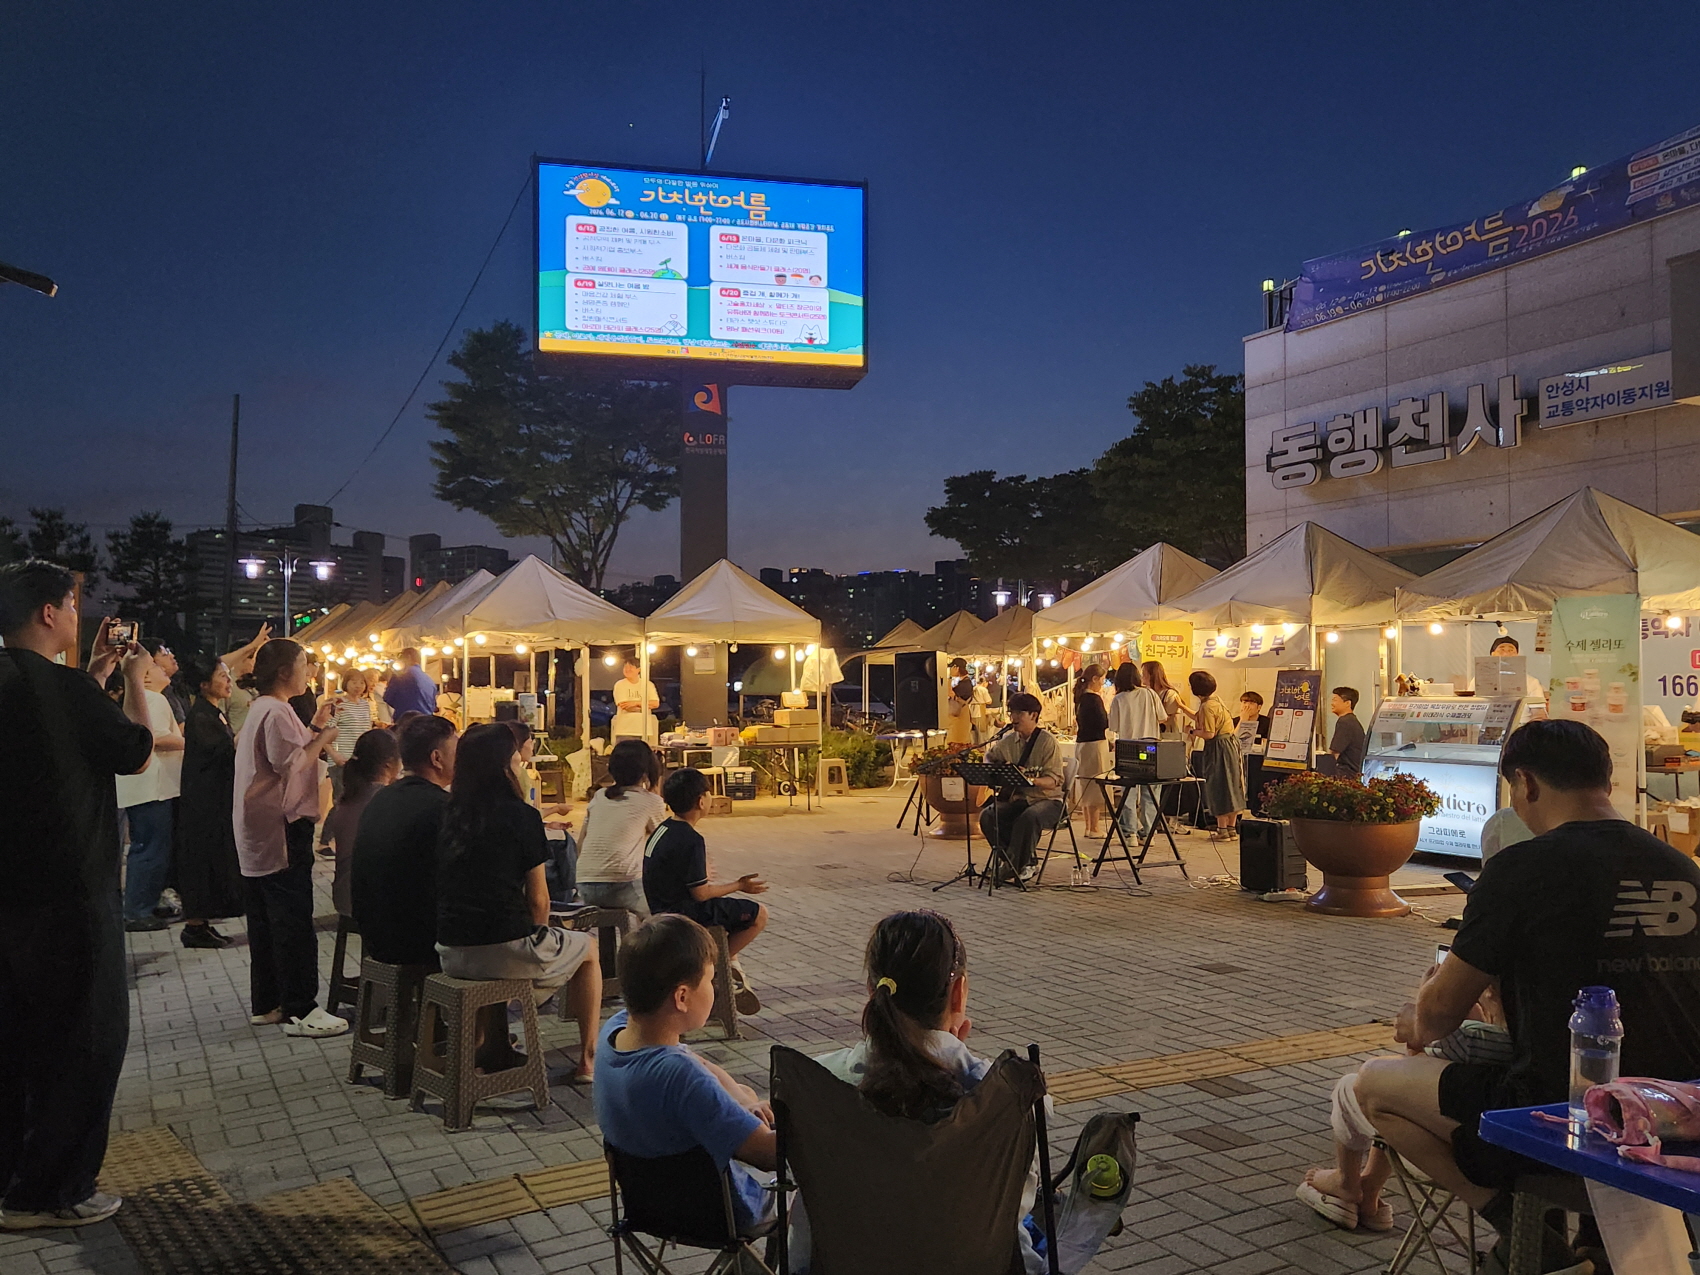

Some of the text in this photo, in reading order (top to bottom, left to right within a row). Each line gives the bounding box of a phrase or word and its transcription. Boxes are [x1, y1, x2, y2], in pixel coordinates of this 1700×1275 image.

[1546, 376, 1590, 400] 안성시
[1546, 380, 1670, 419] 교통약자이동지원
[1270, 374, 1527, 490] 동행천사
[1145, 644, 1190, 658] 친구추가
[1564, 639, 1586, 652] 수제
[1658, 674, 1698, 697] 166
[1604, 880, 1698, 938] NB
[1597, 957, 1642, 973] new
